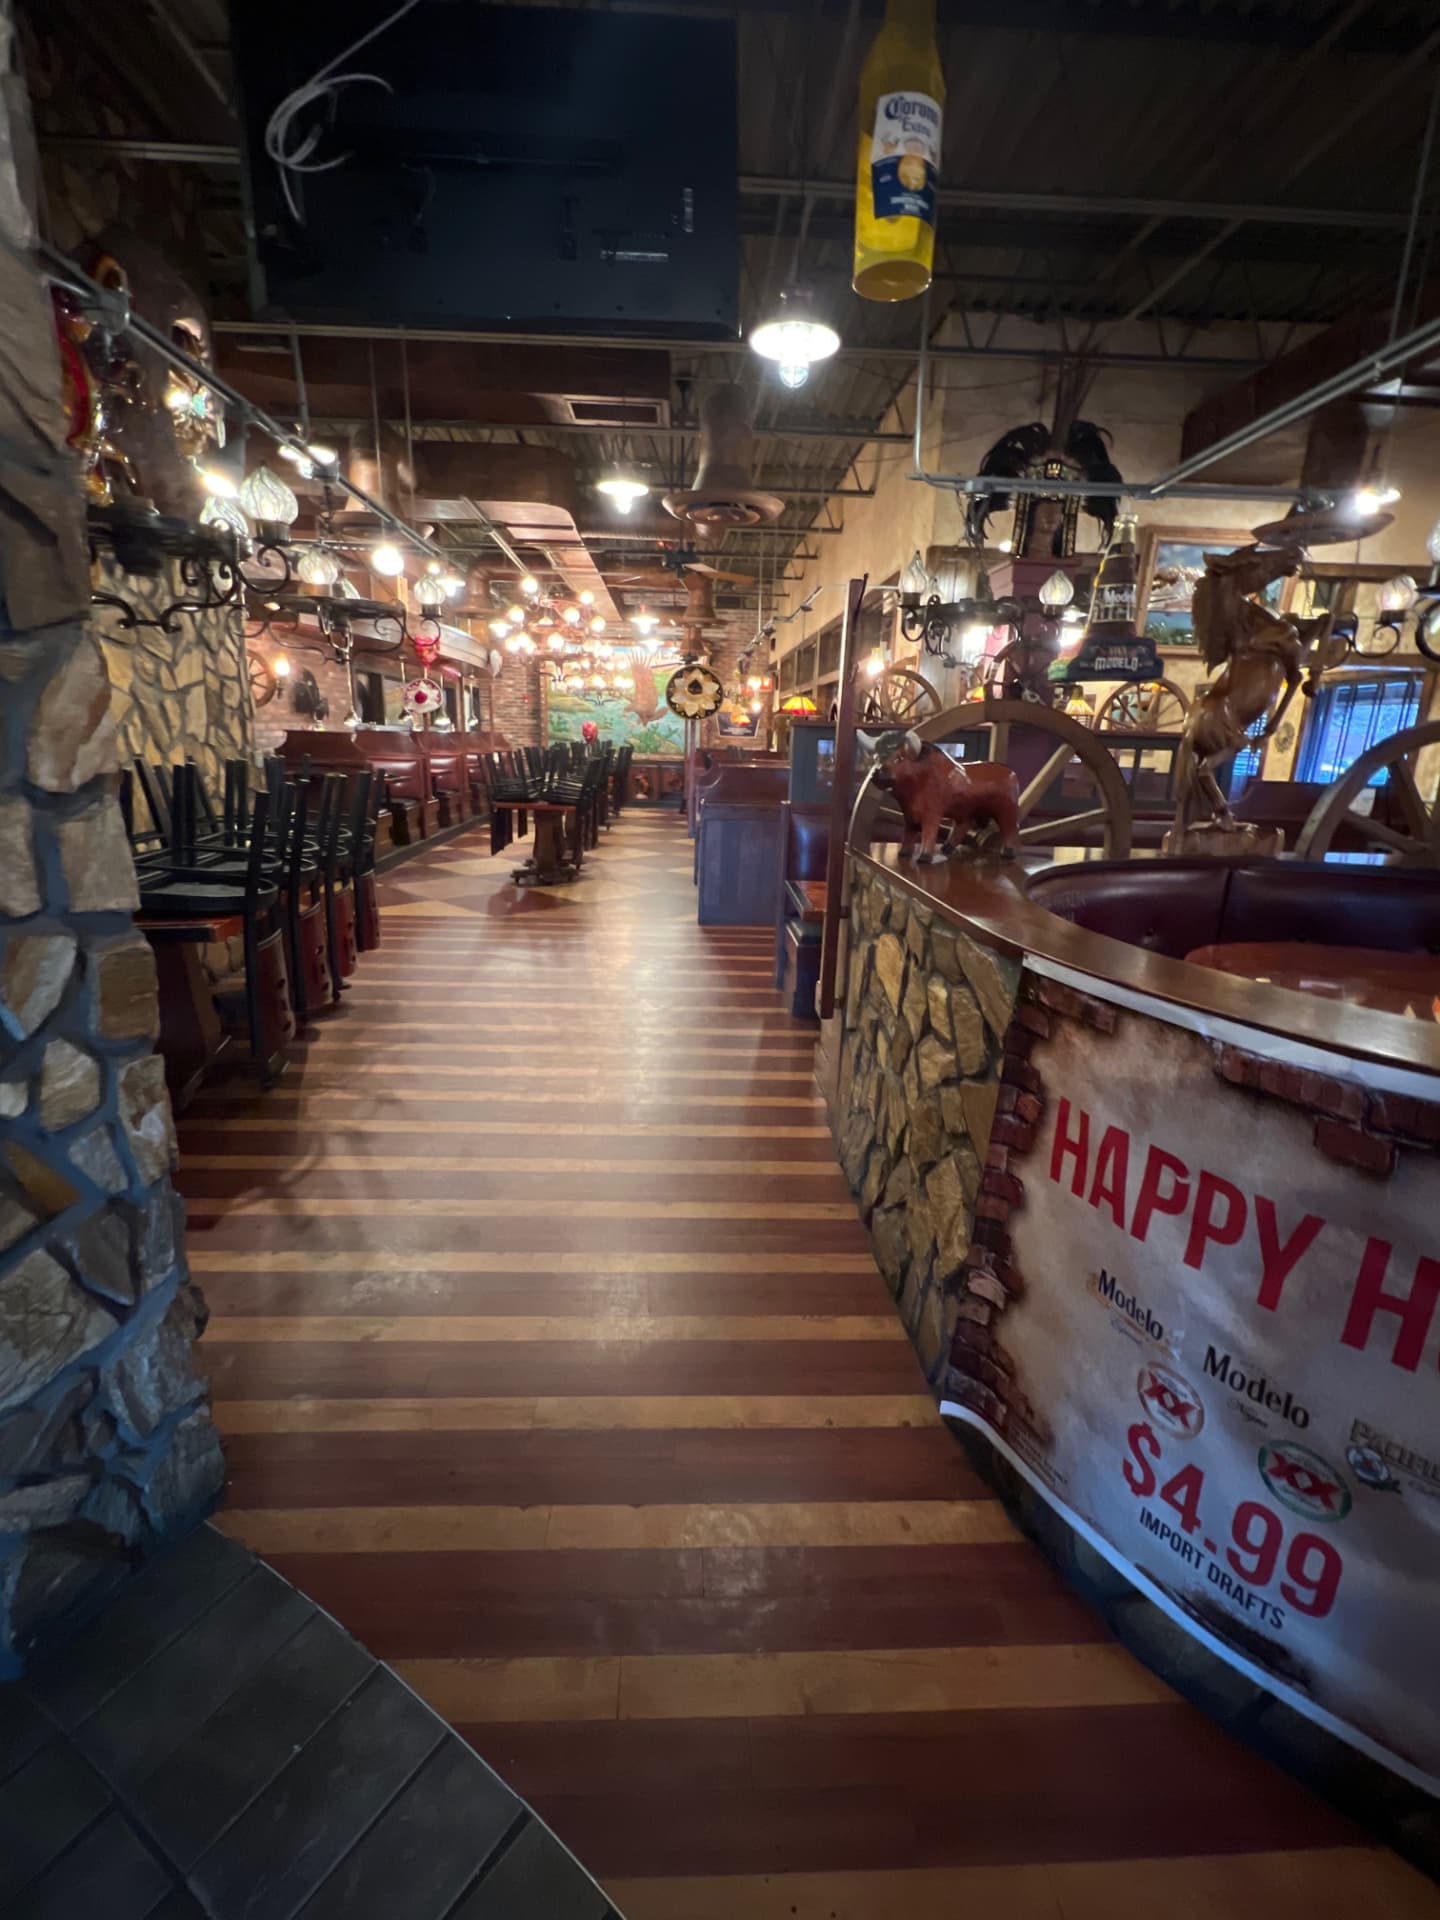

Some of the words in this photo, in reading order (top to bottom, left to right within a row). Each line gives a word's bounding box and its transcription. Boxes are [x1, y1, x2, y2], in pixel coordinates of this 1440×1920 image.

[884, 95, 938, 127] Corona
[1095, 656, 1138, 671] MODELO
[1049, 1097, 1326, 1312] HAPPY
[1340, 1236, 1440, 1374] H
[1098, 1269, 1164, 1341] Modelo
[1143, 1369, 1199, 1429] XX
[1203, 1345, 1310, 1429] Modelo
[1267, 1451, 1341, 1513] XX
[1123, 1421, 1343, 1618] $4.99
[1139, 1506, 1205, 1570] IMPORT
[1207, 1563, 1286, 1630] DRAFTS
